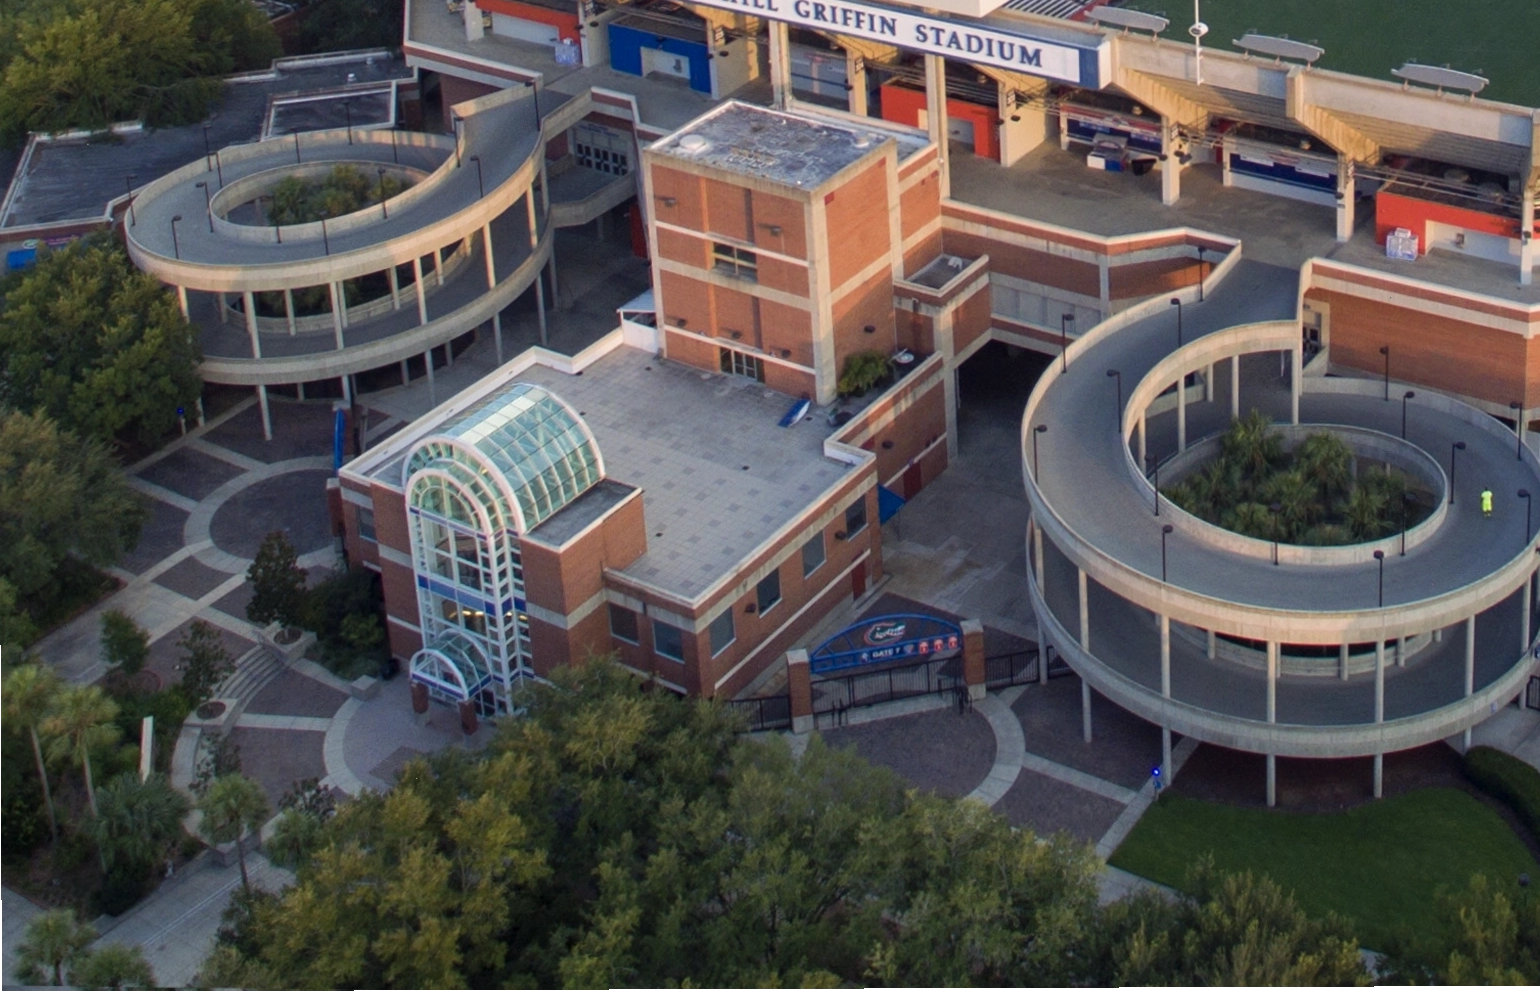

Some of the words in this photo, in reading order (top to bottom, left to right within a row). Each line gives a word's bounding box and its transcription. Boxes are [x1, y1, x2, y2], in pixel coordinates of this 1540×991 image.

[794, 0, 897, 37] GRIFFIN
[915, 24, 1043, 68] STADIUM
[872, 648, 893, 657] GATE
